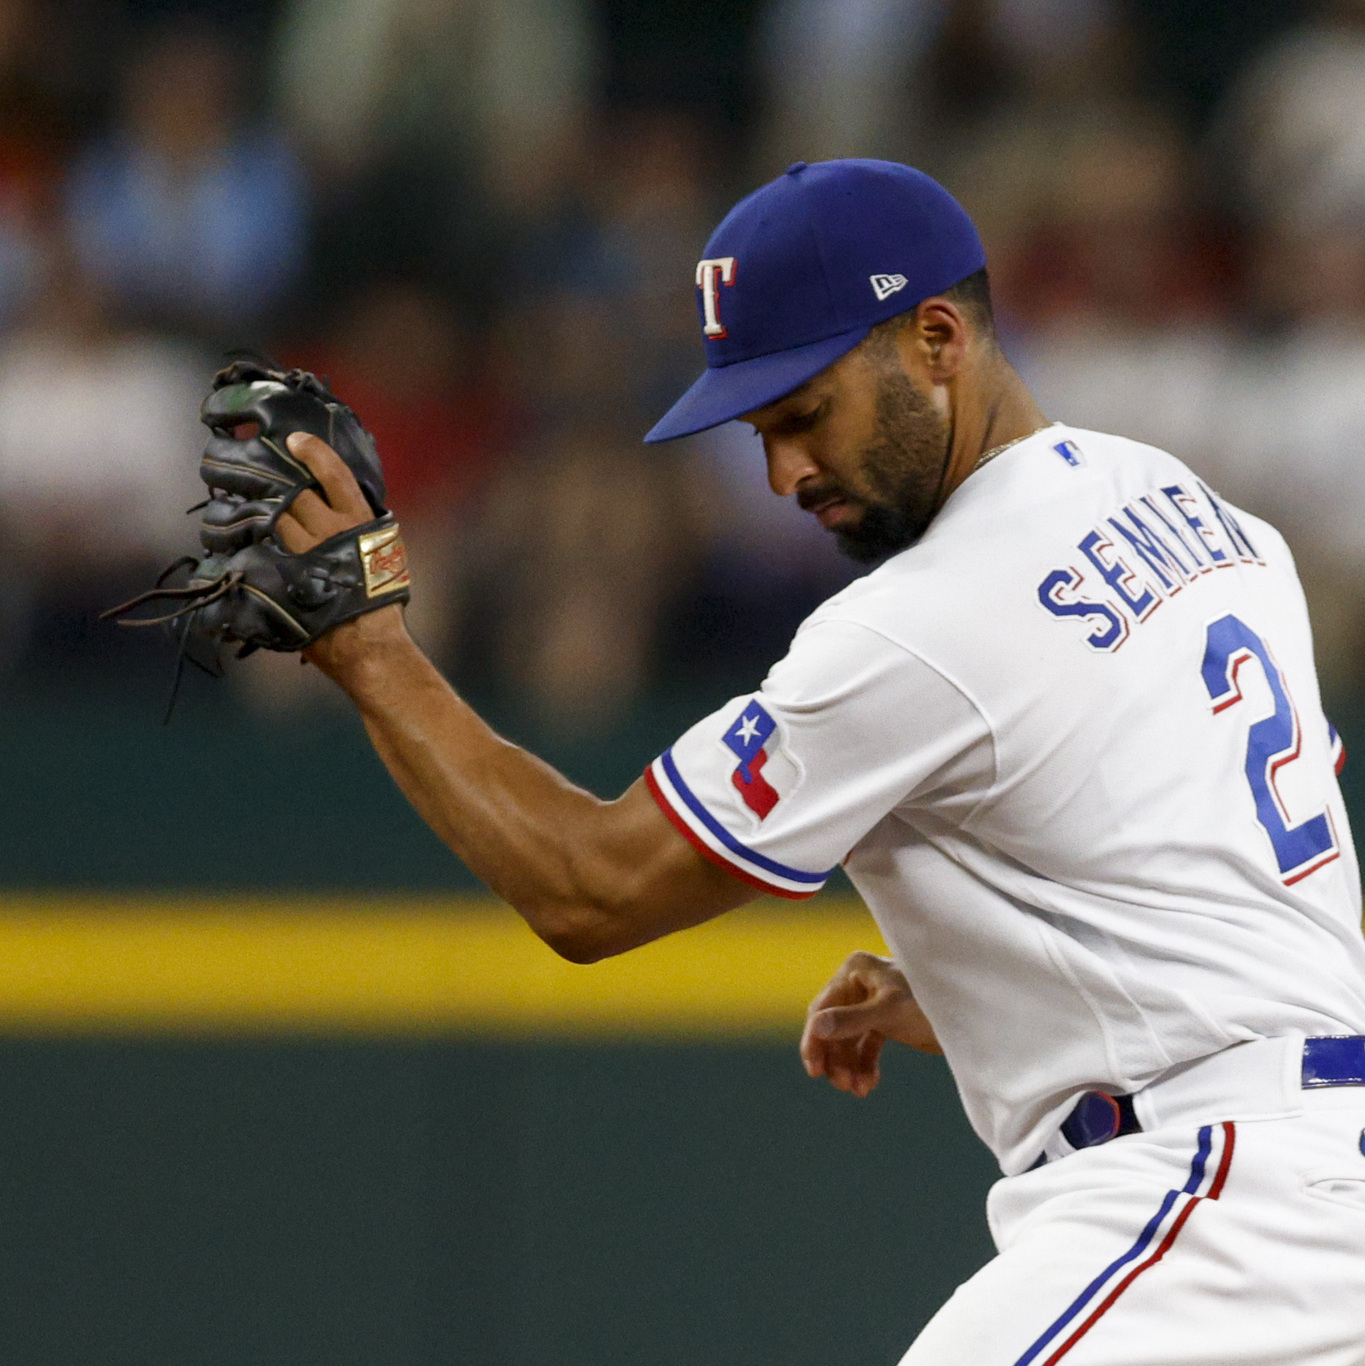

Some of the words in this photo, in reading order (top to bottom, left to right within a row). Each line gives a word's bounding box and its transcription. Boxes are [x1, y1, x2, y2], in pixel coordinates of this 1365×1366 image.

[695, 256, 738, 340] T
[1034, 477, 1267, 654] SEMIEN
[1199, 608, 1341, 888] 2
